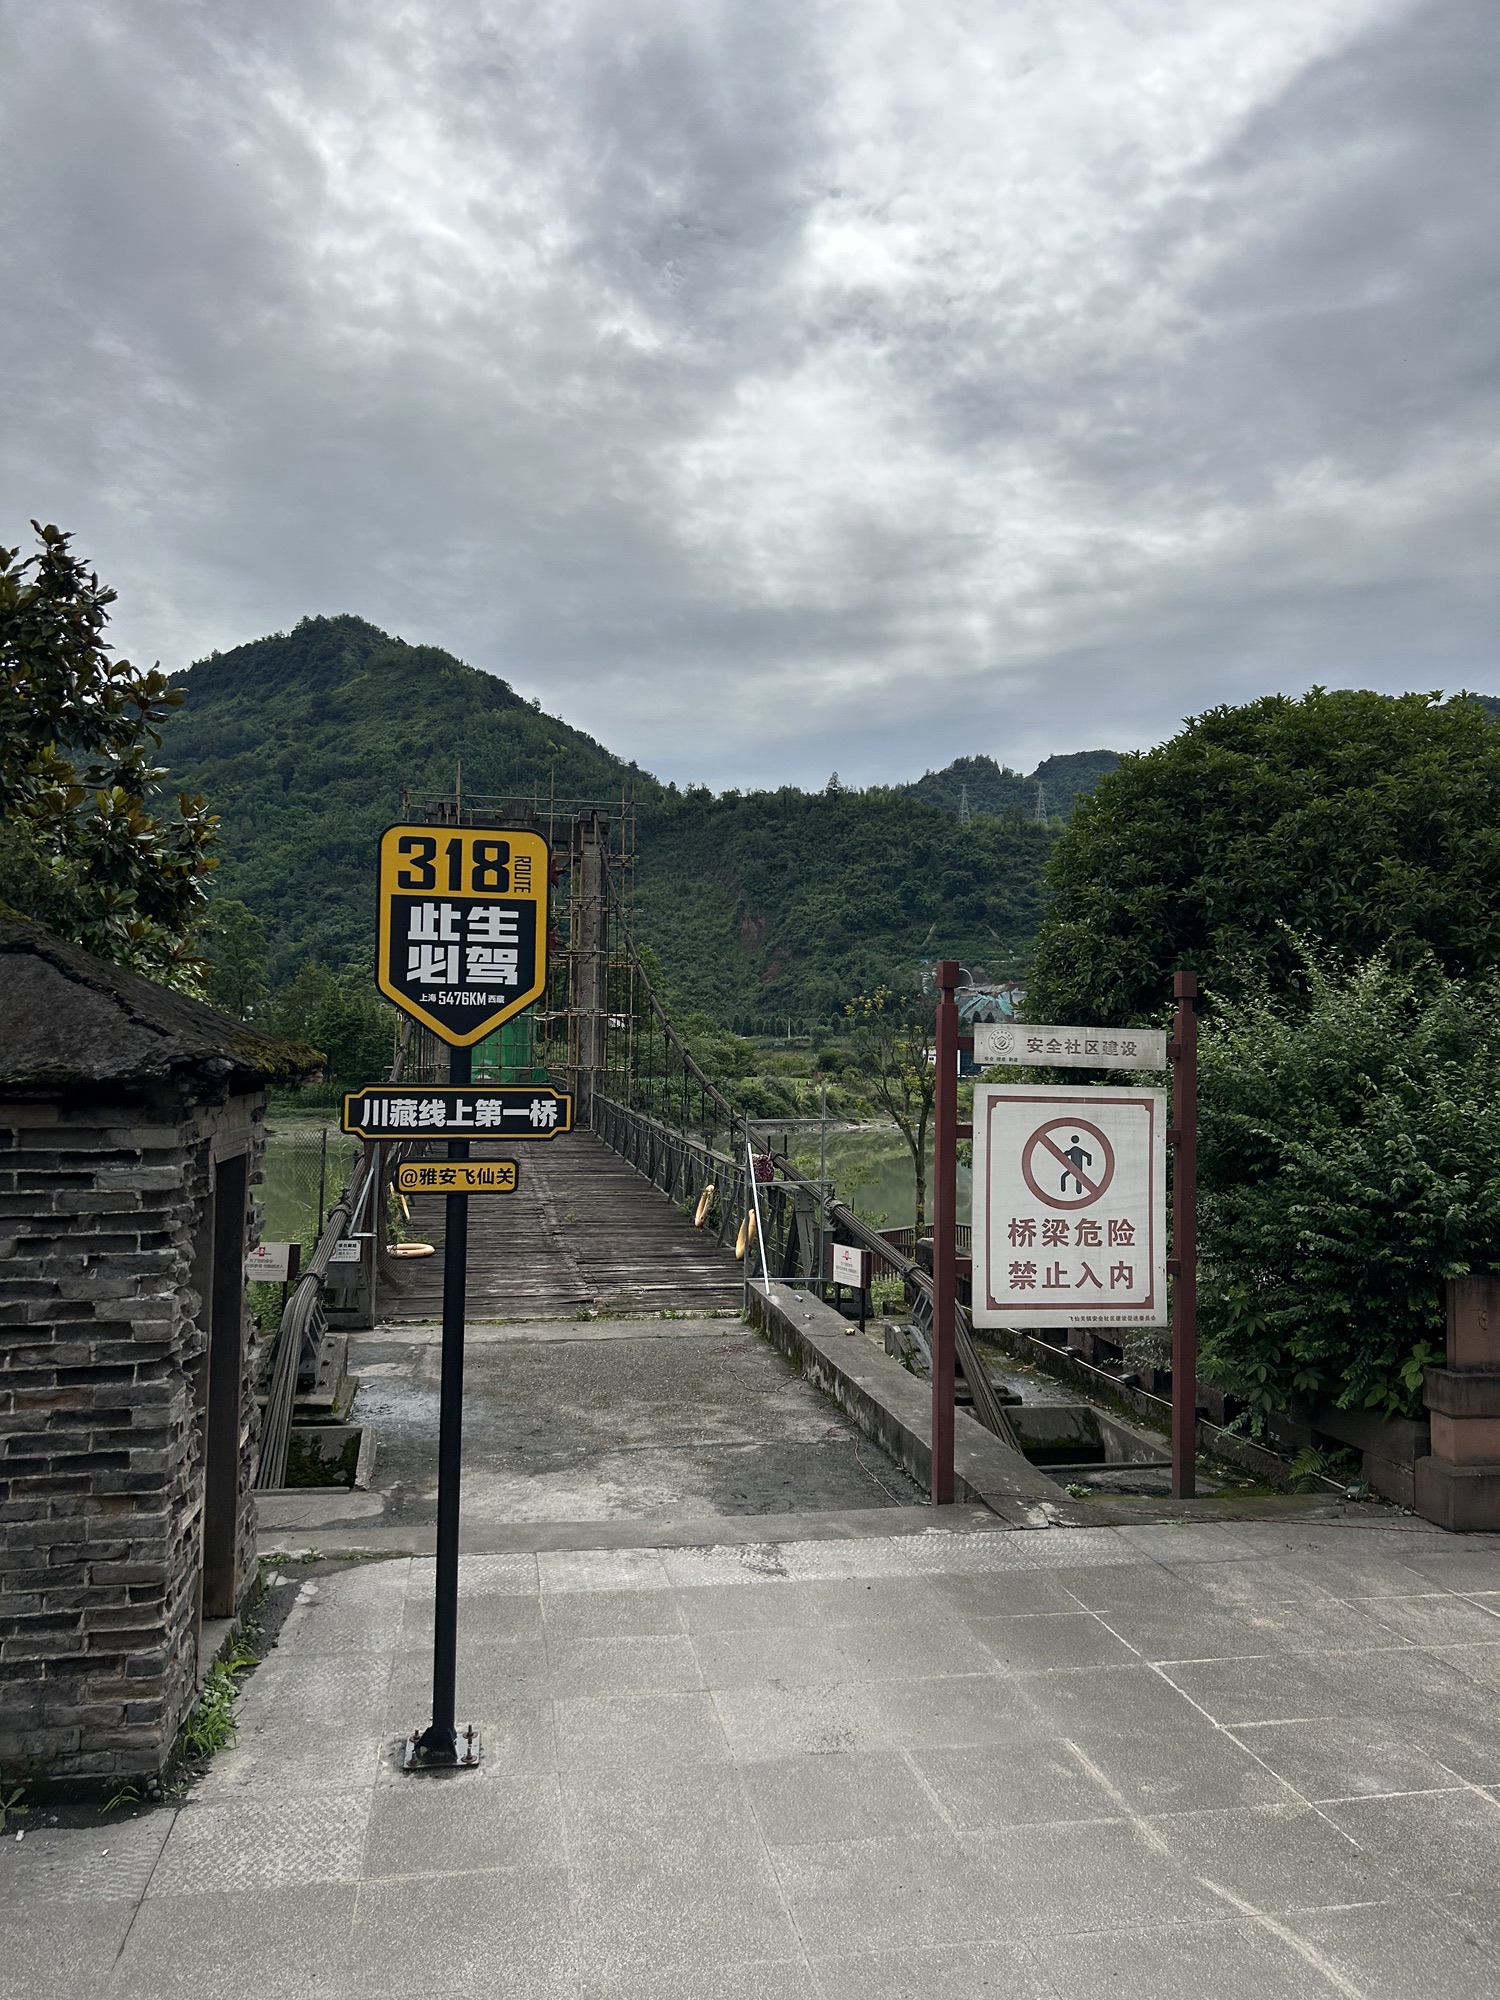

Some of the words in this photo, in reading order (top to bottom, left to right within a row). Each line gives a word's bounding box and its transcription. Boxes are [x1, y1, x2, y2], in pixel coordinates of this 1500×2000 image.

[397, 835, 511, 894] 318
[513, 855, 532, 894] ROUTE
[407, 902, 519, 944] 此生
[406, 944, 519, 986] 必驾
[419, 993, 437, 1003] 上海
[438, 991, 487, 1006] 5476KM
[1026, 1037, 1138, 1057] 安全社区建设
[361, 1098, 559, 1128] 川藏线上第一桥
[400, 1167, 514, 1188] @雅安飞仙关
[1008, 1217, 1136, 1248] 桥梁危险
[1008, 1260, 1135, 1290] 禁止入内
